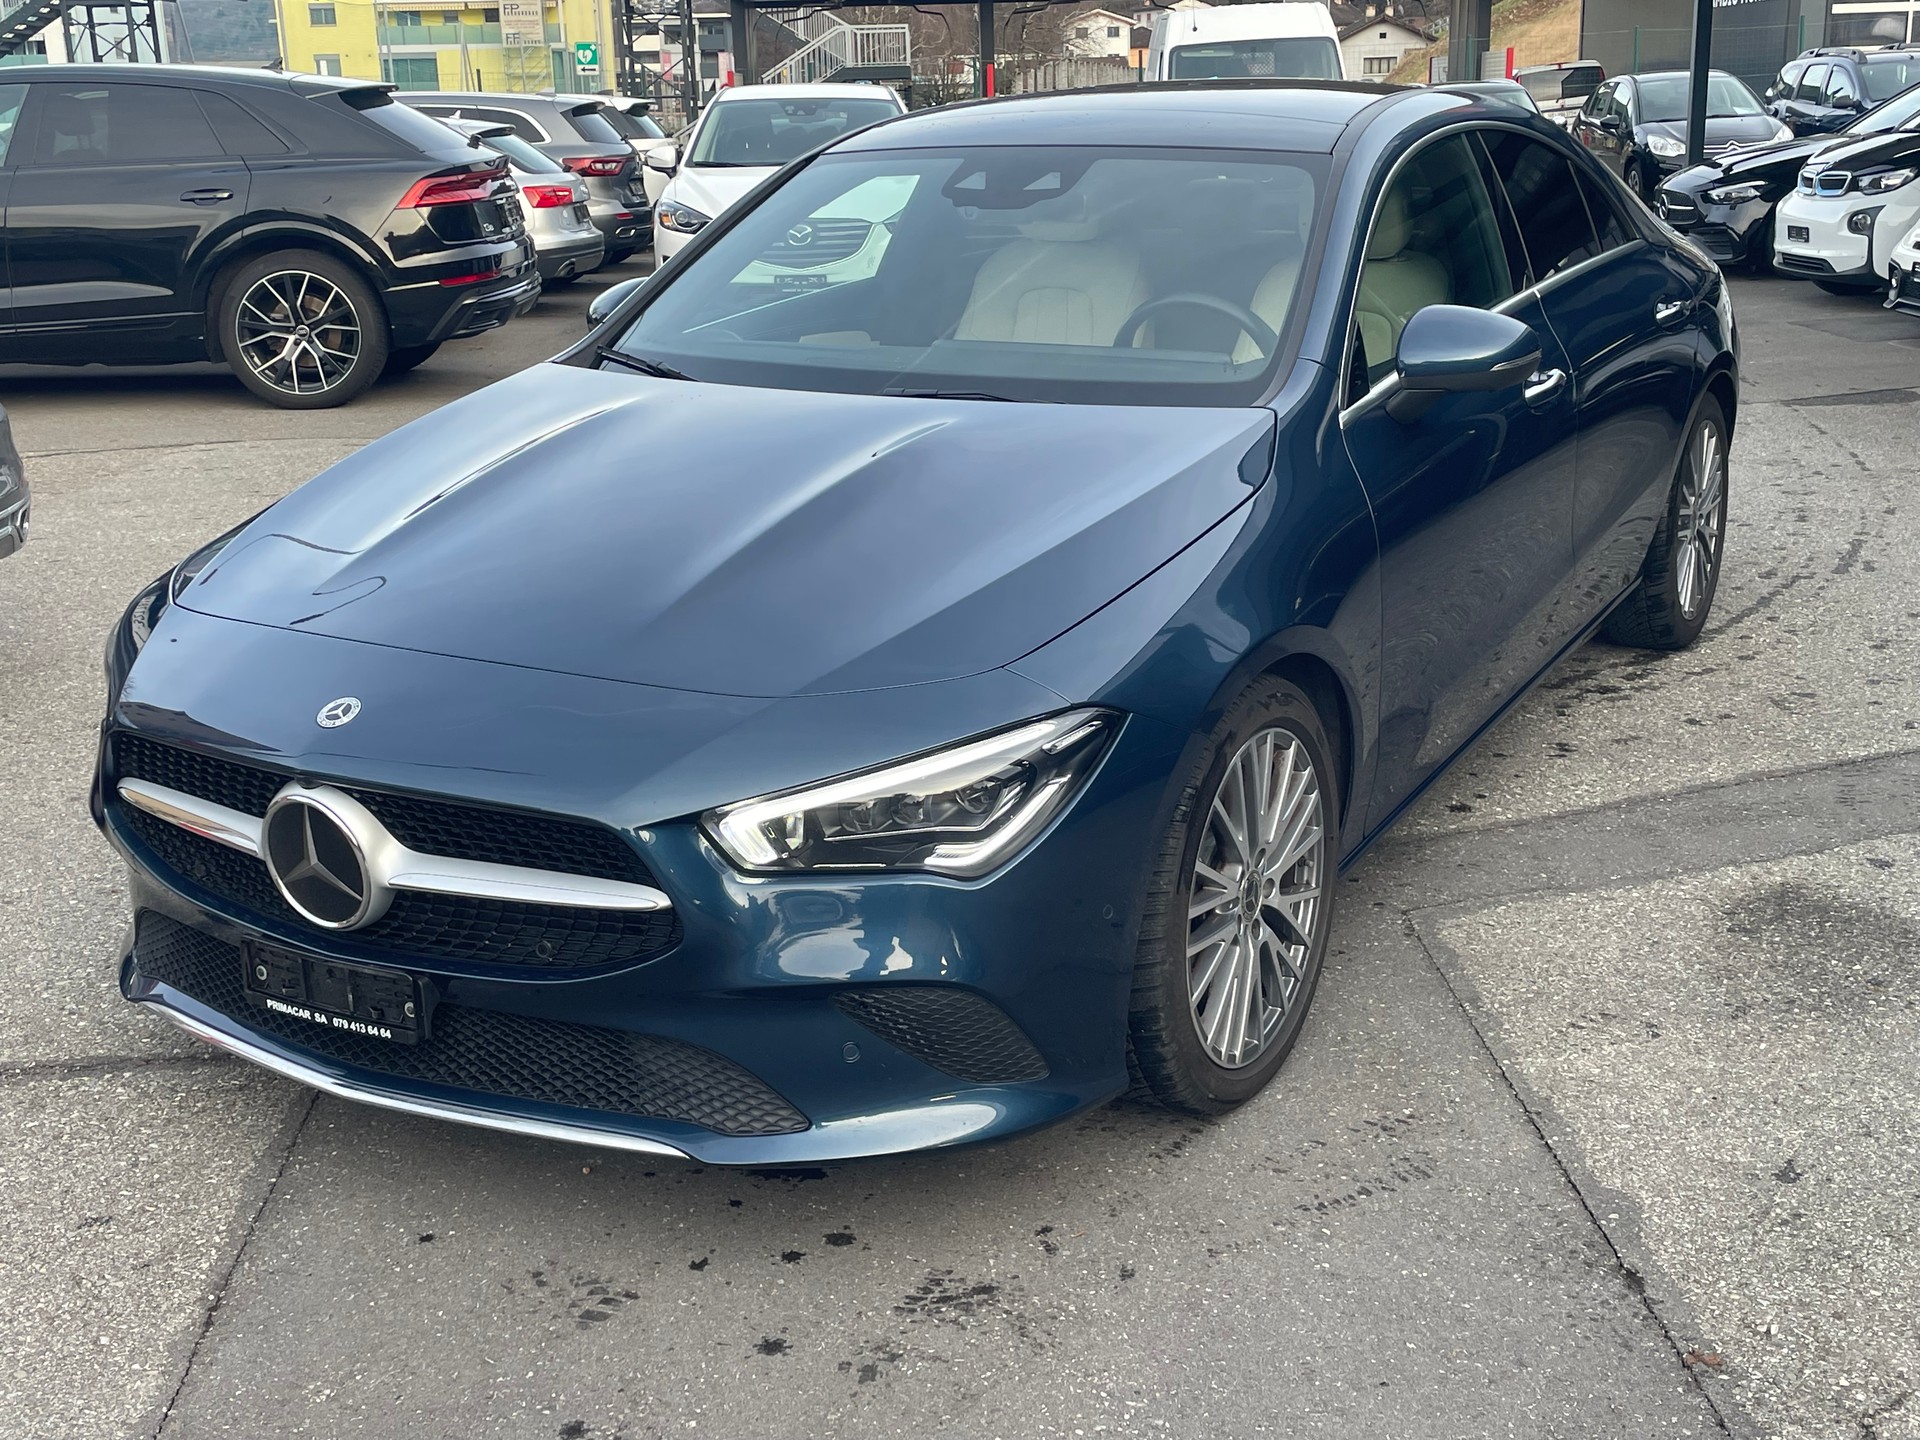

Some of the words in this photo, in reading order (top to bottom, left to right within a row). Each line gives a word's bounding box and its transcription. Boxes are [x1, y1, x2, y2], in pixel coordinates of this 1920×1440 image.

[266, 999, 311, 1019] PRIMACAR
[314, 1012, 328, 1024] SA
[332, 1017, 348, 1029] 079
[350, 1021, 366, 1033] 413
[367, 1025, 379, 1036] 64
[380, 1028, 391, 1039] 64
